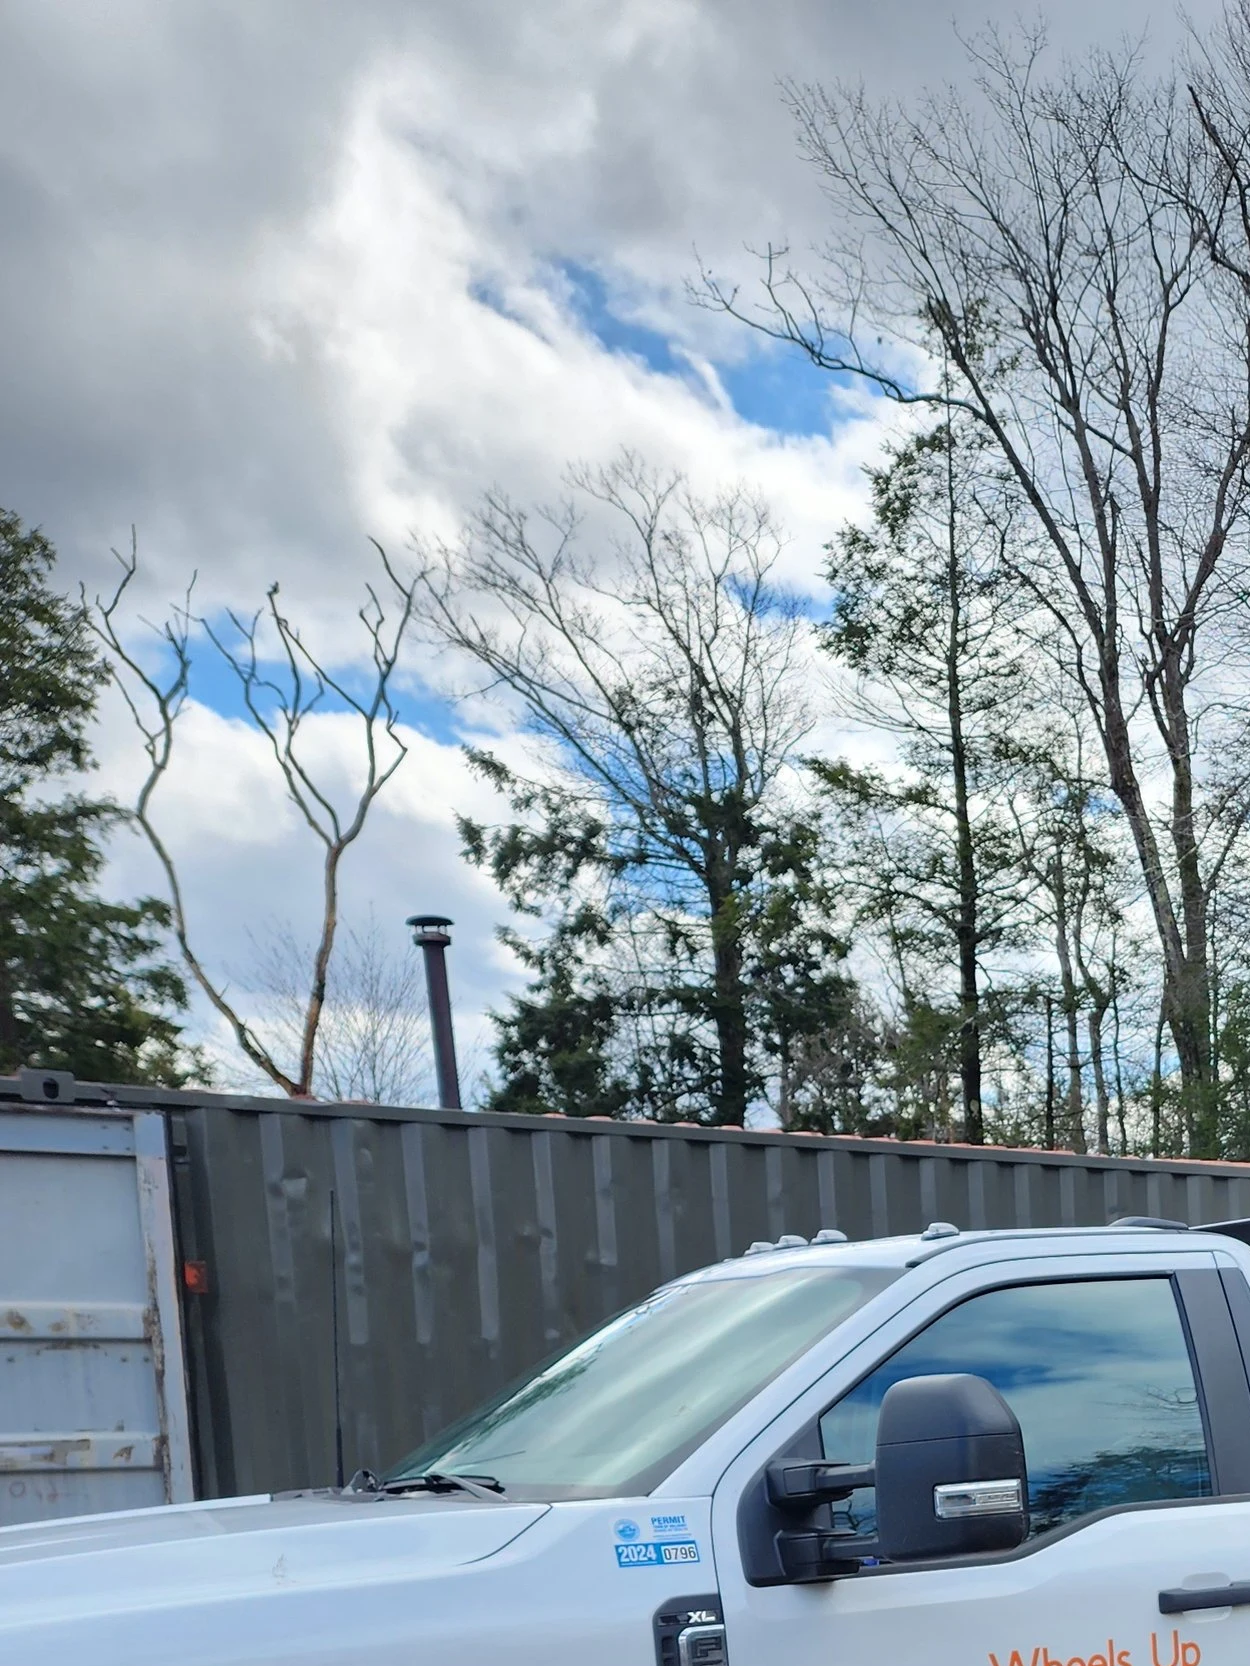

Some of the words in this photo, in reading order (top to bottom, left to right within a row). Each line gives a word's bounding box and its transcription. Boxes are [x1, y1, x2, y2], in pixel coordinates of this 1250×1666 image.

[651, 1515, 686, 1525] PERMIT
[618, 1545, 656, 1562] 2024
[663, 1547, 696, 1560] 0796
[687, 1611, 716, 1623] XL
